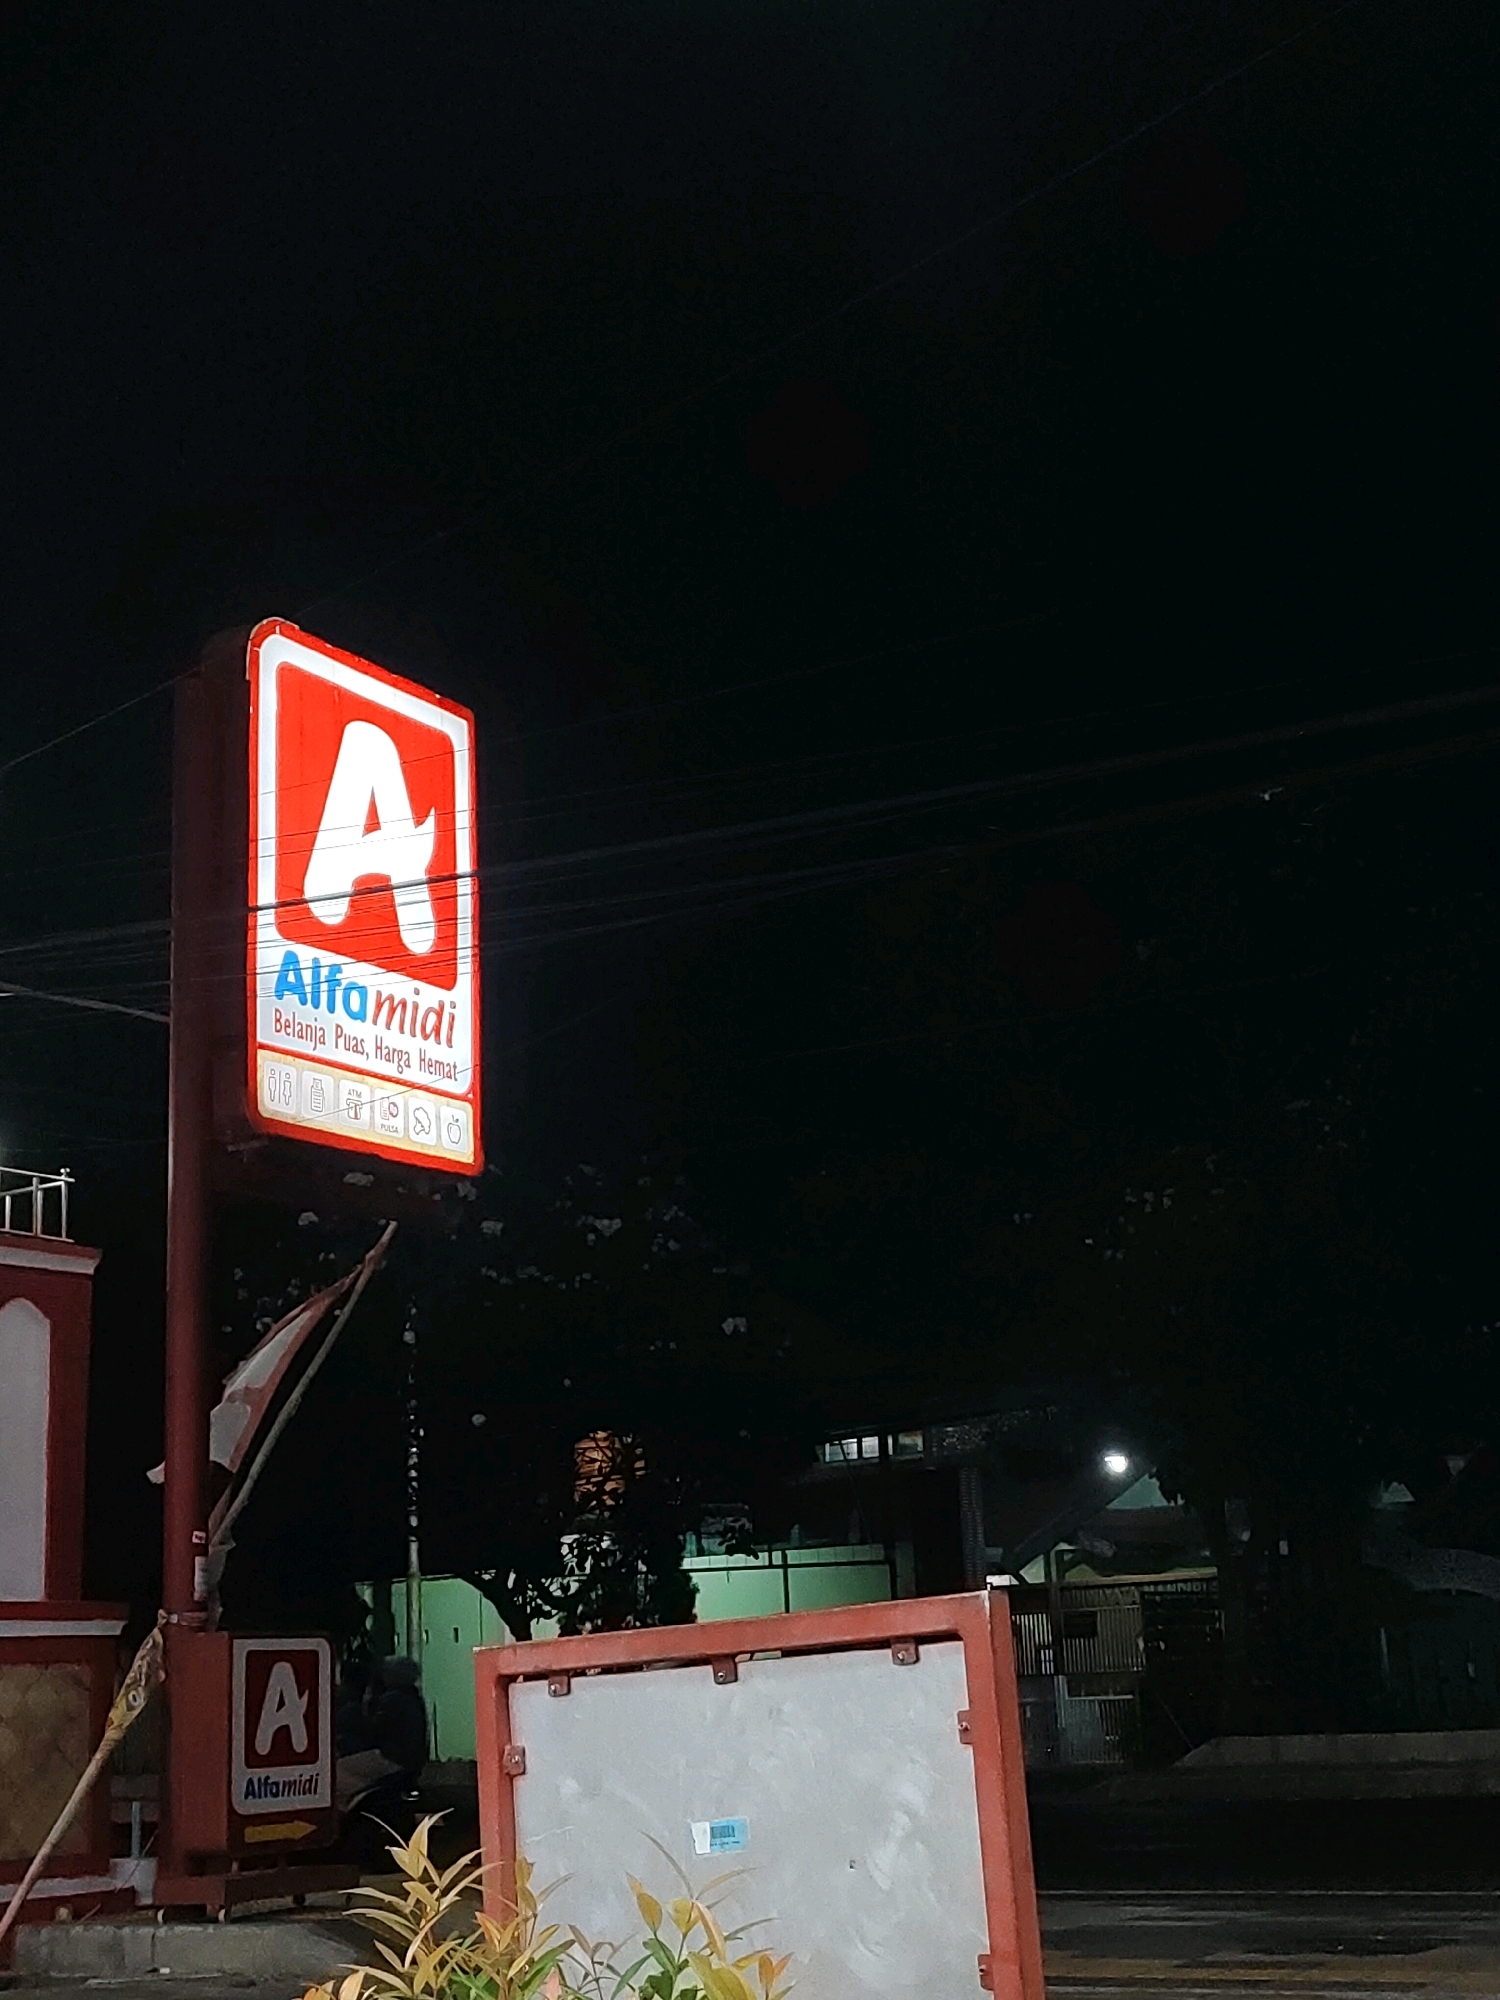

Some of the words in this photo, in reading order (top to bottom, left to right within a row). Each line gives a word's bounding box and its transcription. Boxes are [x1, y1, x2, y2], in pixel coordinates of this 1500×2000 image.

[274, 950, 457, 1049] Alfamidi
[274, 1007, 326, 1051] Belanja
[335, 1023, 370, 1061] Puas,
[375, 1034, 411, 1074] Harga
[419, 1048, 458, 1081] Hemat
[347, 1088, 362, 1099] ATM
[380, 1123, 399, 1134] PULSA
[244, 1773, 320, 1800] Alfamidi
